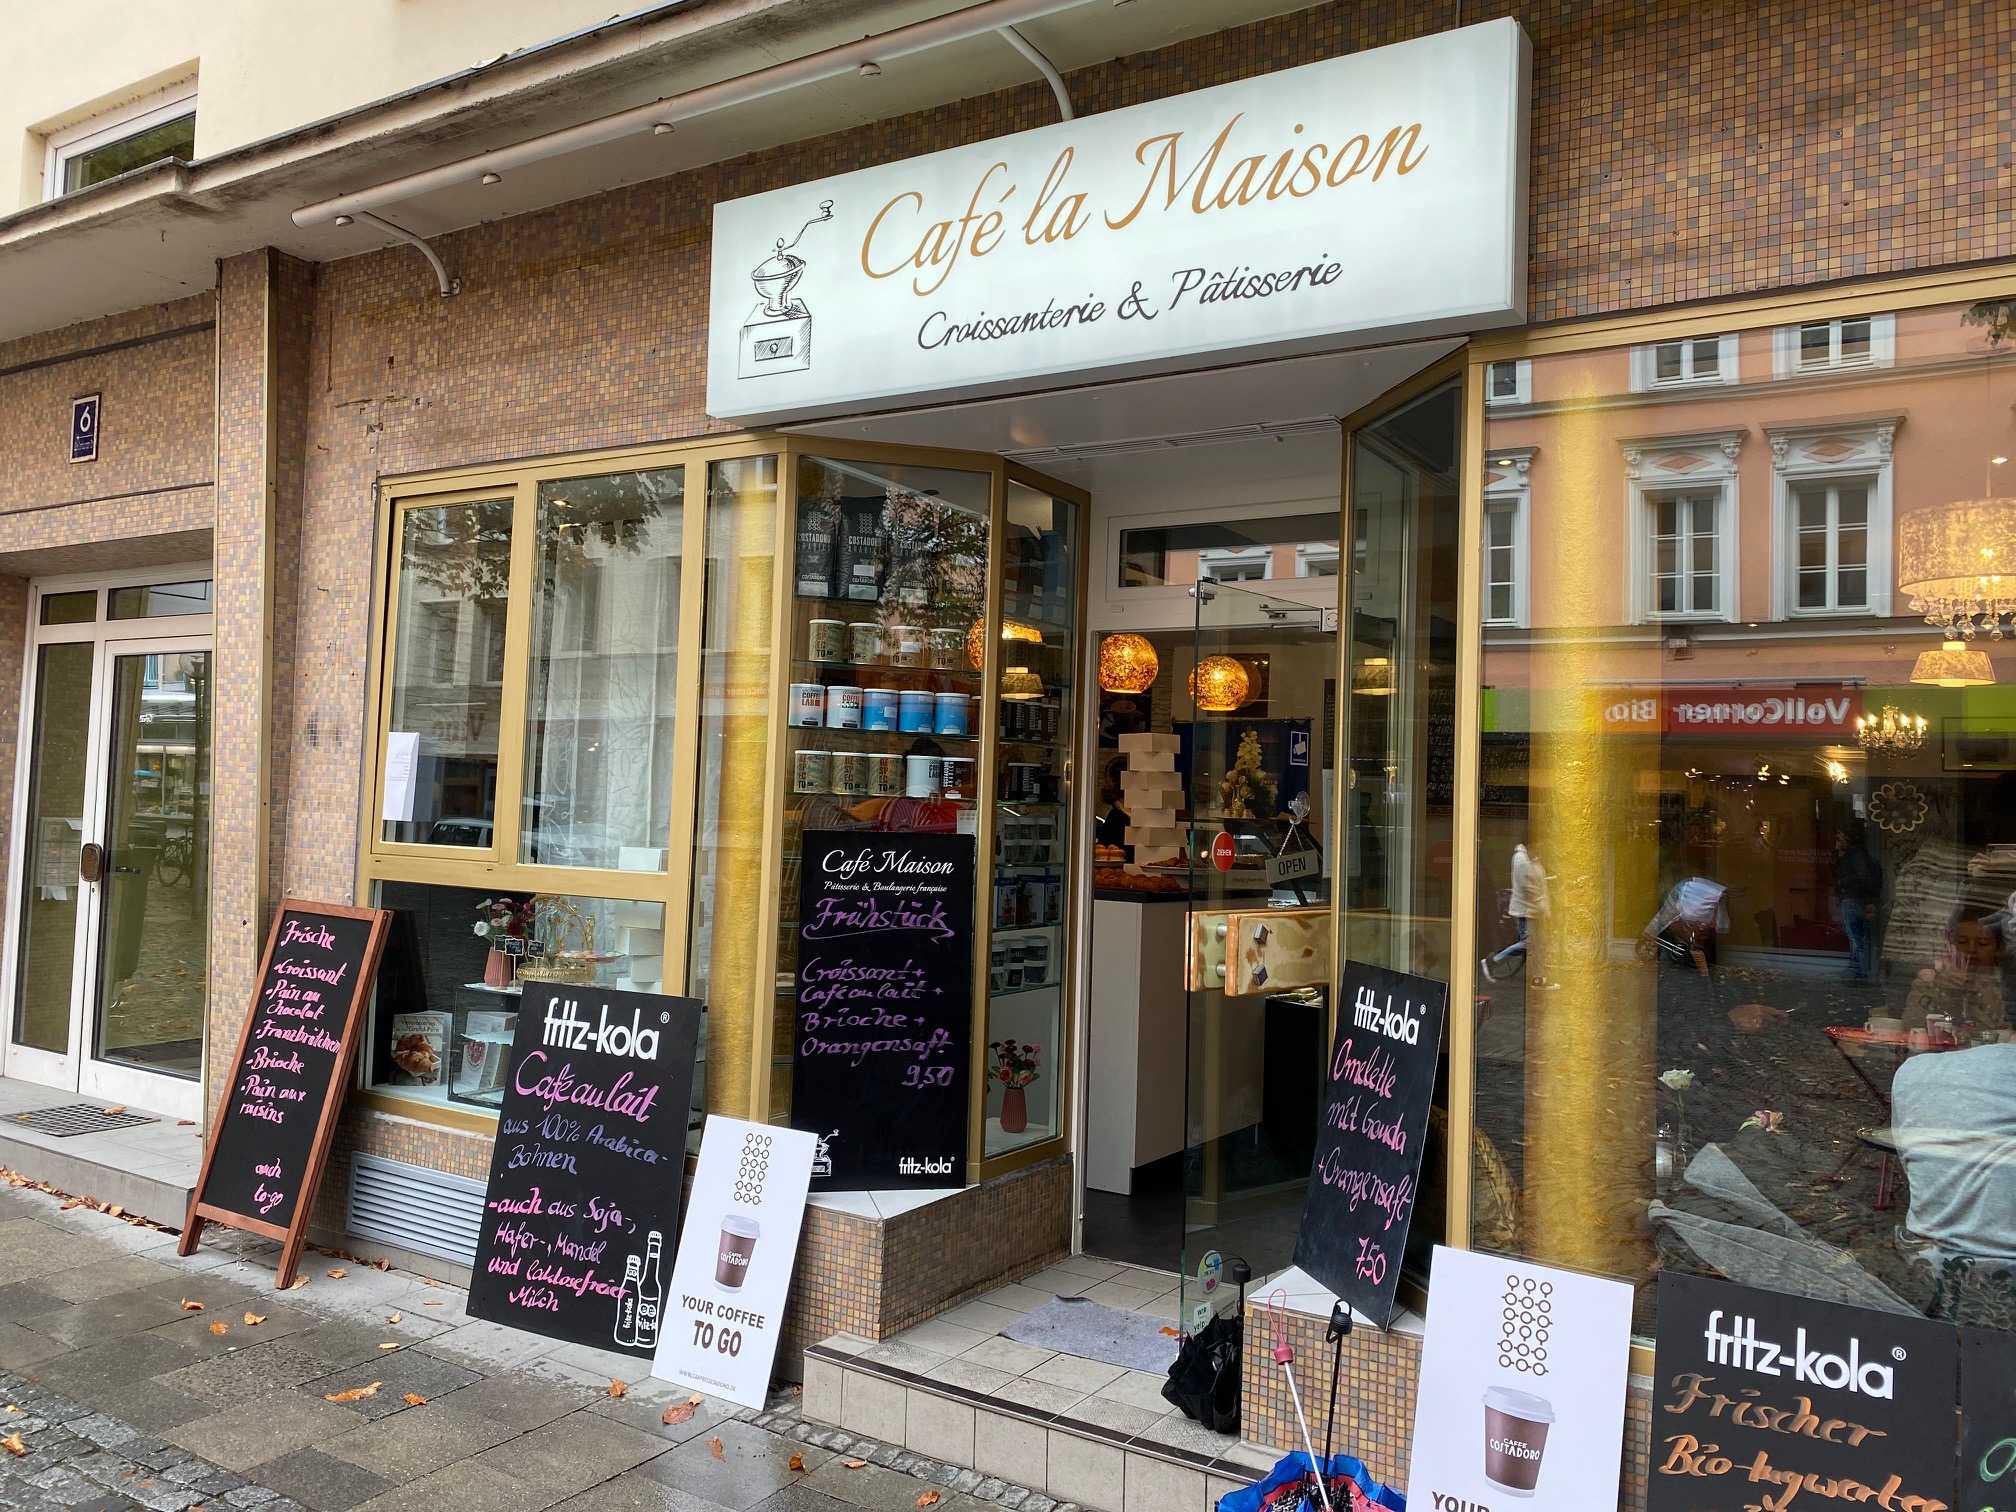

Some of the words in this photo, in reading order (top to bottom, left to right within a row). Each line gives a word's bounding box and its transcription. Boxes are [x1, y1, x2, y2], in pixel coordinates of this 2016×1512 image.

[861, 161, 1016, 296] Café
[1022, 146, 1090, 243] la
[1103, 112, 1429, 230] Maison
[918, 280, 1106, 350] Croissanterie
[1118, 281, 1158, 320] &
[1168, 252, 1344, 311] Pâtisserie
[80, 405, 91, 432] 6
[844, 782, 853, 790] TO
[878, 784, 887, 792] TO
[822, 848, 874, 880] Café
[873, 850, 954, 875] Maison
[1278, 857, 1307, 876] OPEN
[824, 881, 860, 891] Pâtisserie
[861, 883, 871, 891] &
[873, 882, 917, 895] Boulangerie
[912, 882, 948, 894] française
[815, 897, 948, 931] Frühstück
[280, 920, 336, 951] Frische
[802, 957, 912, 983] Croissant
[302, 990, 321, 1002] au
[800, 984, 849, 1010] Café
[876, 980, 928, 999] lait
[543, 997, 660, 1060] fritz-kola
[801, 1007, 909, 1032] Brioche
[1354, 985, 1420, 1046] fritz-kola
[801, 1028, 954, 1067] Orangensaft
[901, 1065, 955, 1089] 9,50
[1333, 1038, 1397, 1099] Omelette
[279, 1088, 307, 1102] aux
[515, 1051, 576, 1112] Café
[571, 1083, 605, 1108] au
[604, 1071, 660, 1123] lait
[239, 1100, 285, 1124] raisins
[1327, 1095, 1362, 1132] mit
[1361, 1101, 1408, 1155] Gouda
[503, 1118, 530, 1134] aus
[536, 1113, 581, 1143] 100%
[255, 1157, 282, 1179] auch
[508, 1143, 578, 1175] Bohnen
[899, 1156, 952, 1175] fritz-kola
[547, 1200, 578, 1217] aus
[554, 1231, 607, 1264] Mandel
[720, 1253, 749, 1266] COSTADORO
[487, 1256, 522, 1275] und
[509, 1286, 559, 1312] Milch
[682, 1294, 714, 1316] YOUR
[717, 1305, 765, 1329] COFFEE
[693, 1319, 714, 1350] TO
[717, 1327, 742, 1357] GO
[1704, 1310, 1895, 1400] fritz-kola
[1664, 1372, 1888, 1447] Frischer
[1490, 1438, 1540, 1461] COSTADORO
